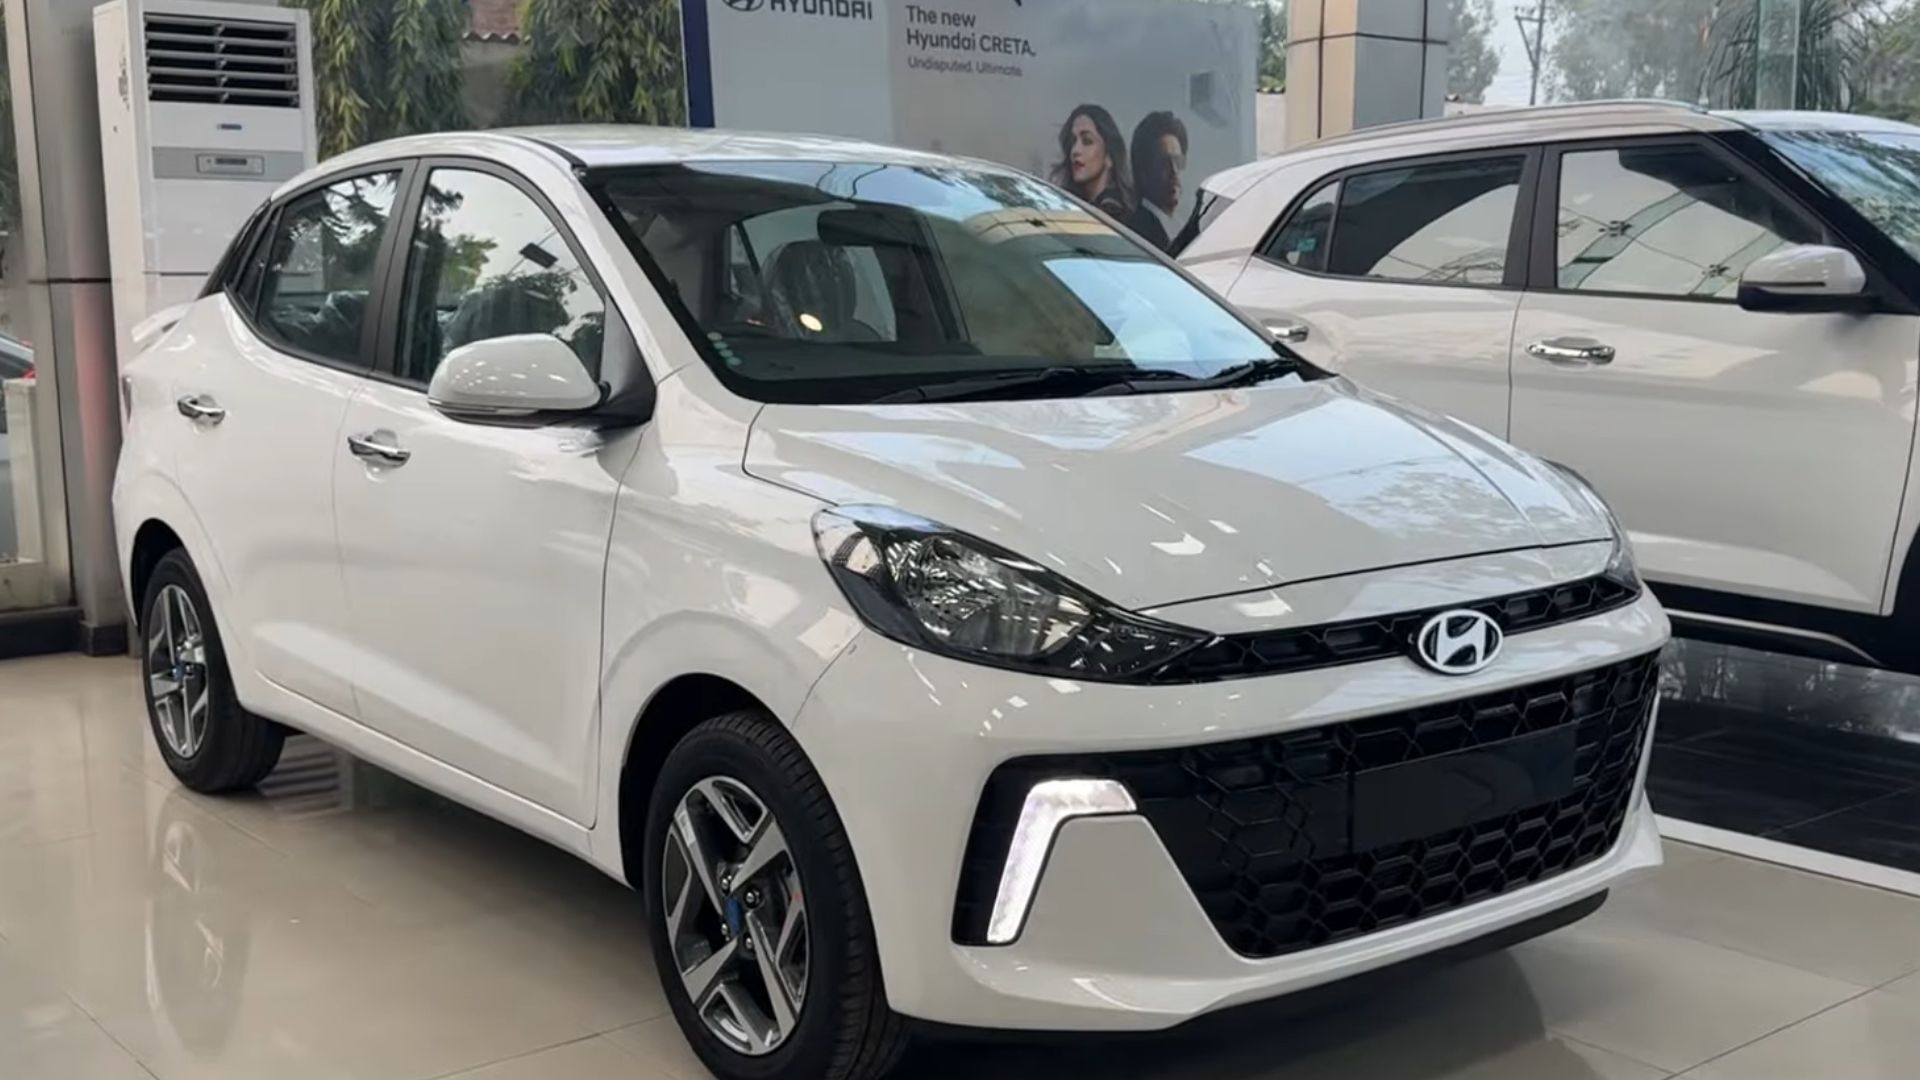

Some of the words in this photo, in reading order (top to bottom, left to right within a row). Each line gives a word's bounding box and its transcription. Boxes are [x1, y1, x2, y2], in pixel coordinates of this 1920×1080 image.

[906, 5, 937, 24] The
[941, 11, 976, 28] new
[907, 27, 976, 51] Hyundai
